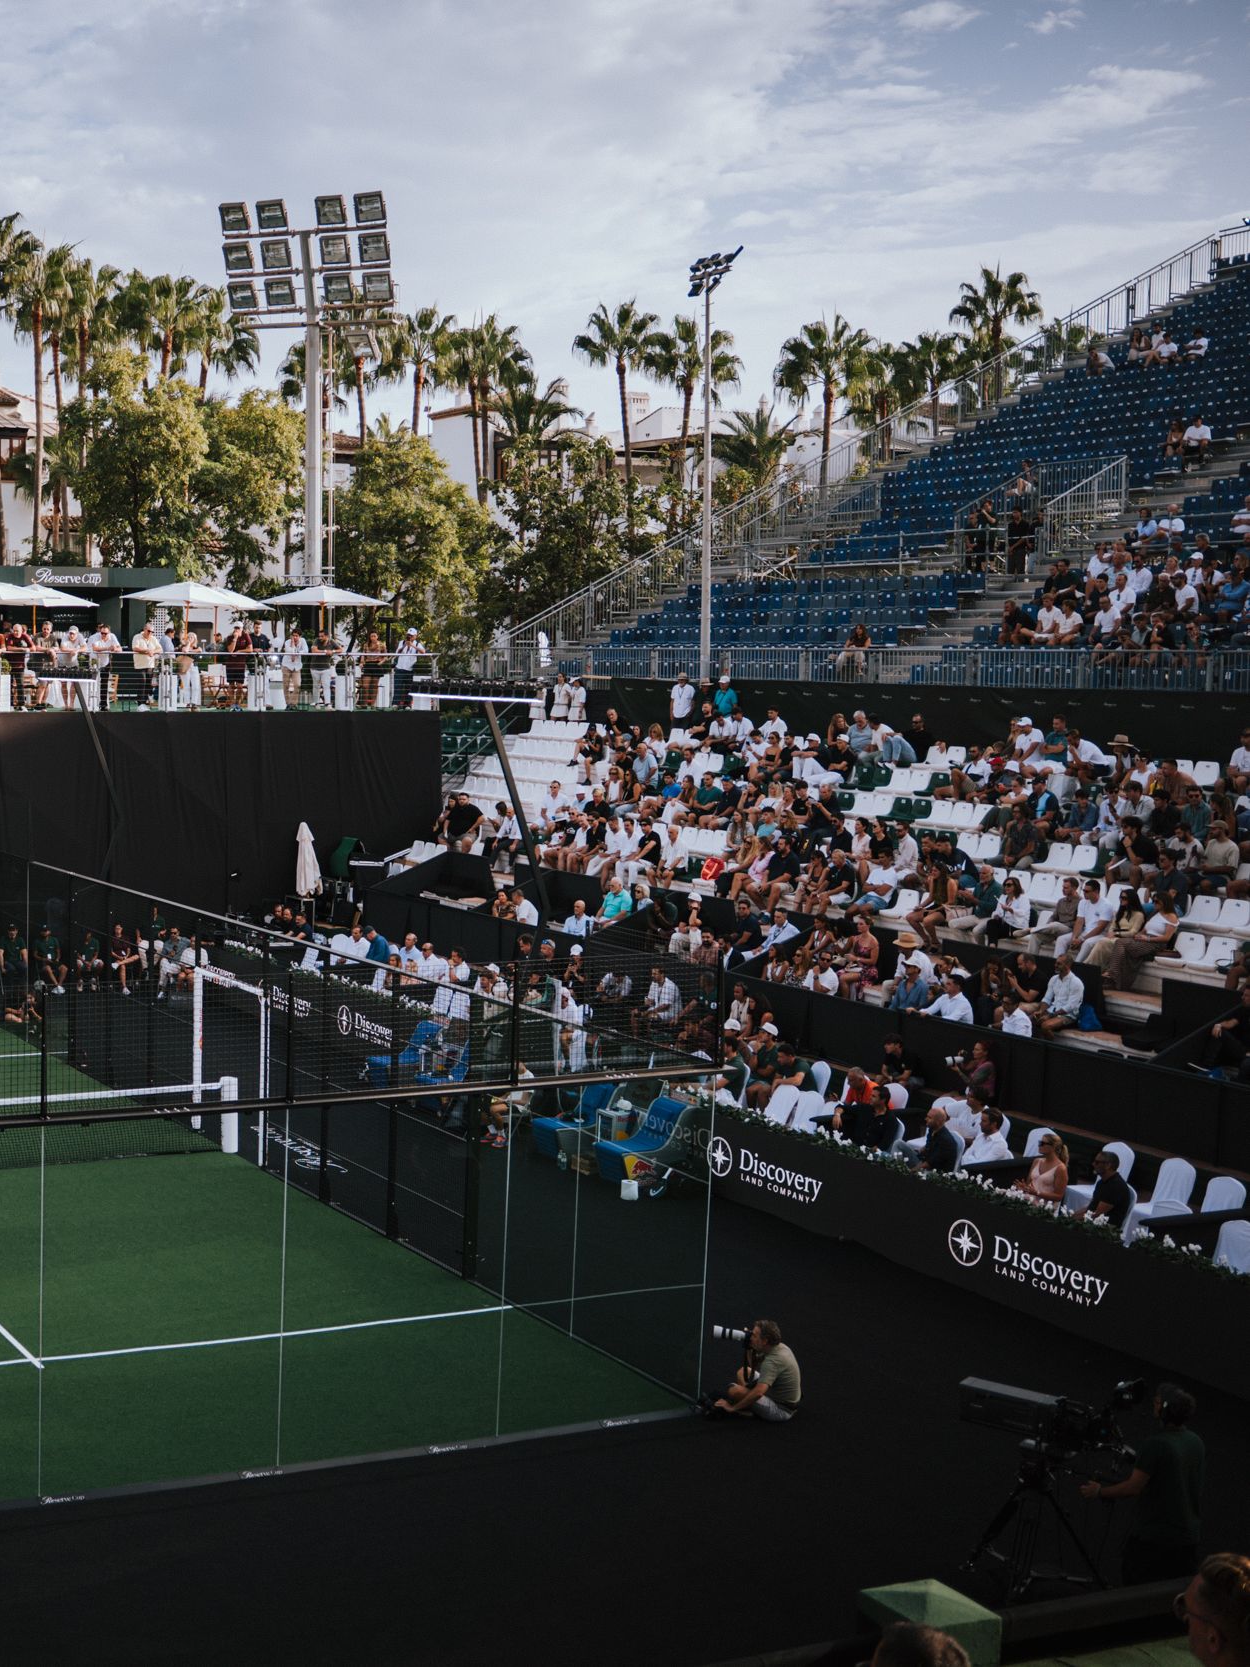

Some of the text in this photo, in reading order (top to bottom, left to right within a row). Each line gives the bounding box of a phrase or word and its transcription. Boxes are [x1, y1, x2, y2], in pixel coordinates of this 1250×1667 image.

[36, 568, 102, 586] Reserve Cup
[739, 1148, 822, 1202] Discovery
[740, 1173, 810, 1204] LAND COMPANY
[992, 1235, 1109, 1305] Discovery
[994, 1264, 1092, 1307] LAND COMPANY
